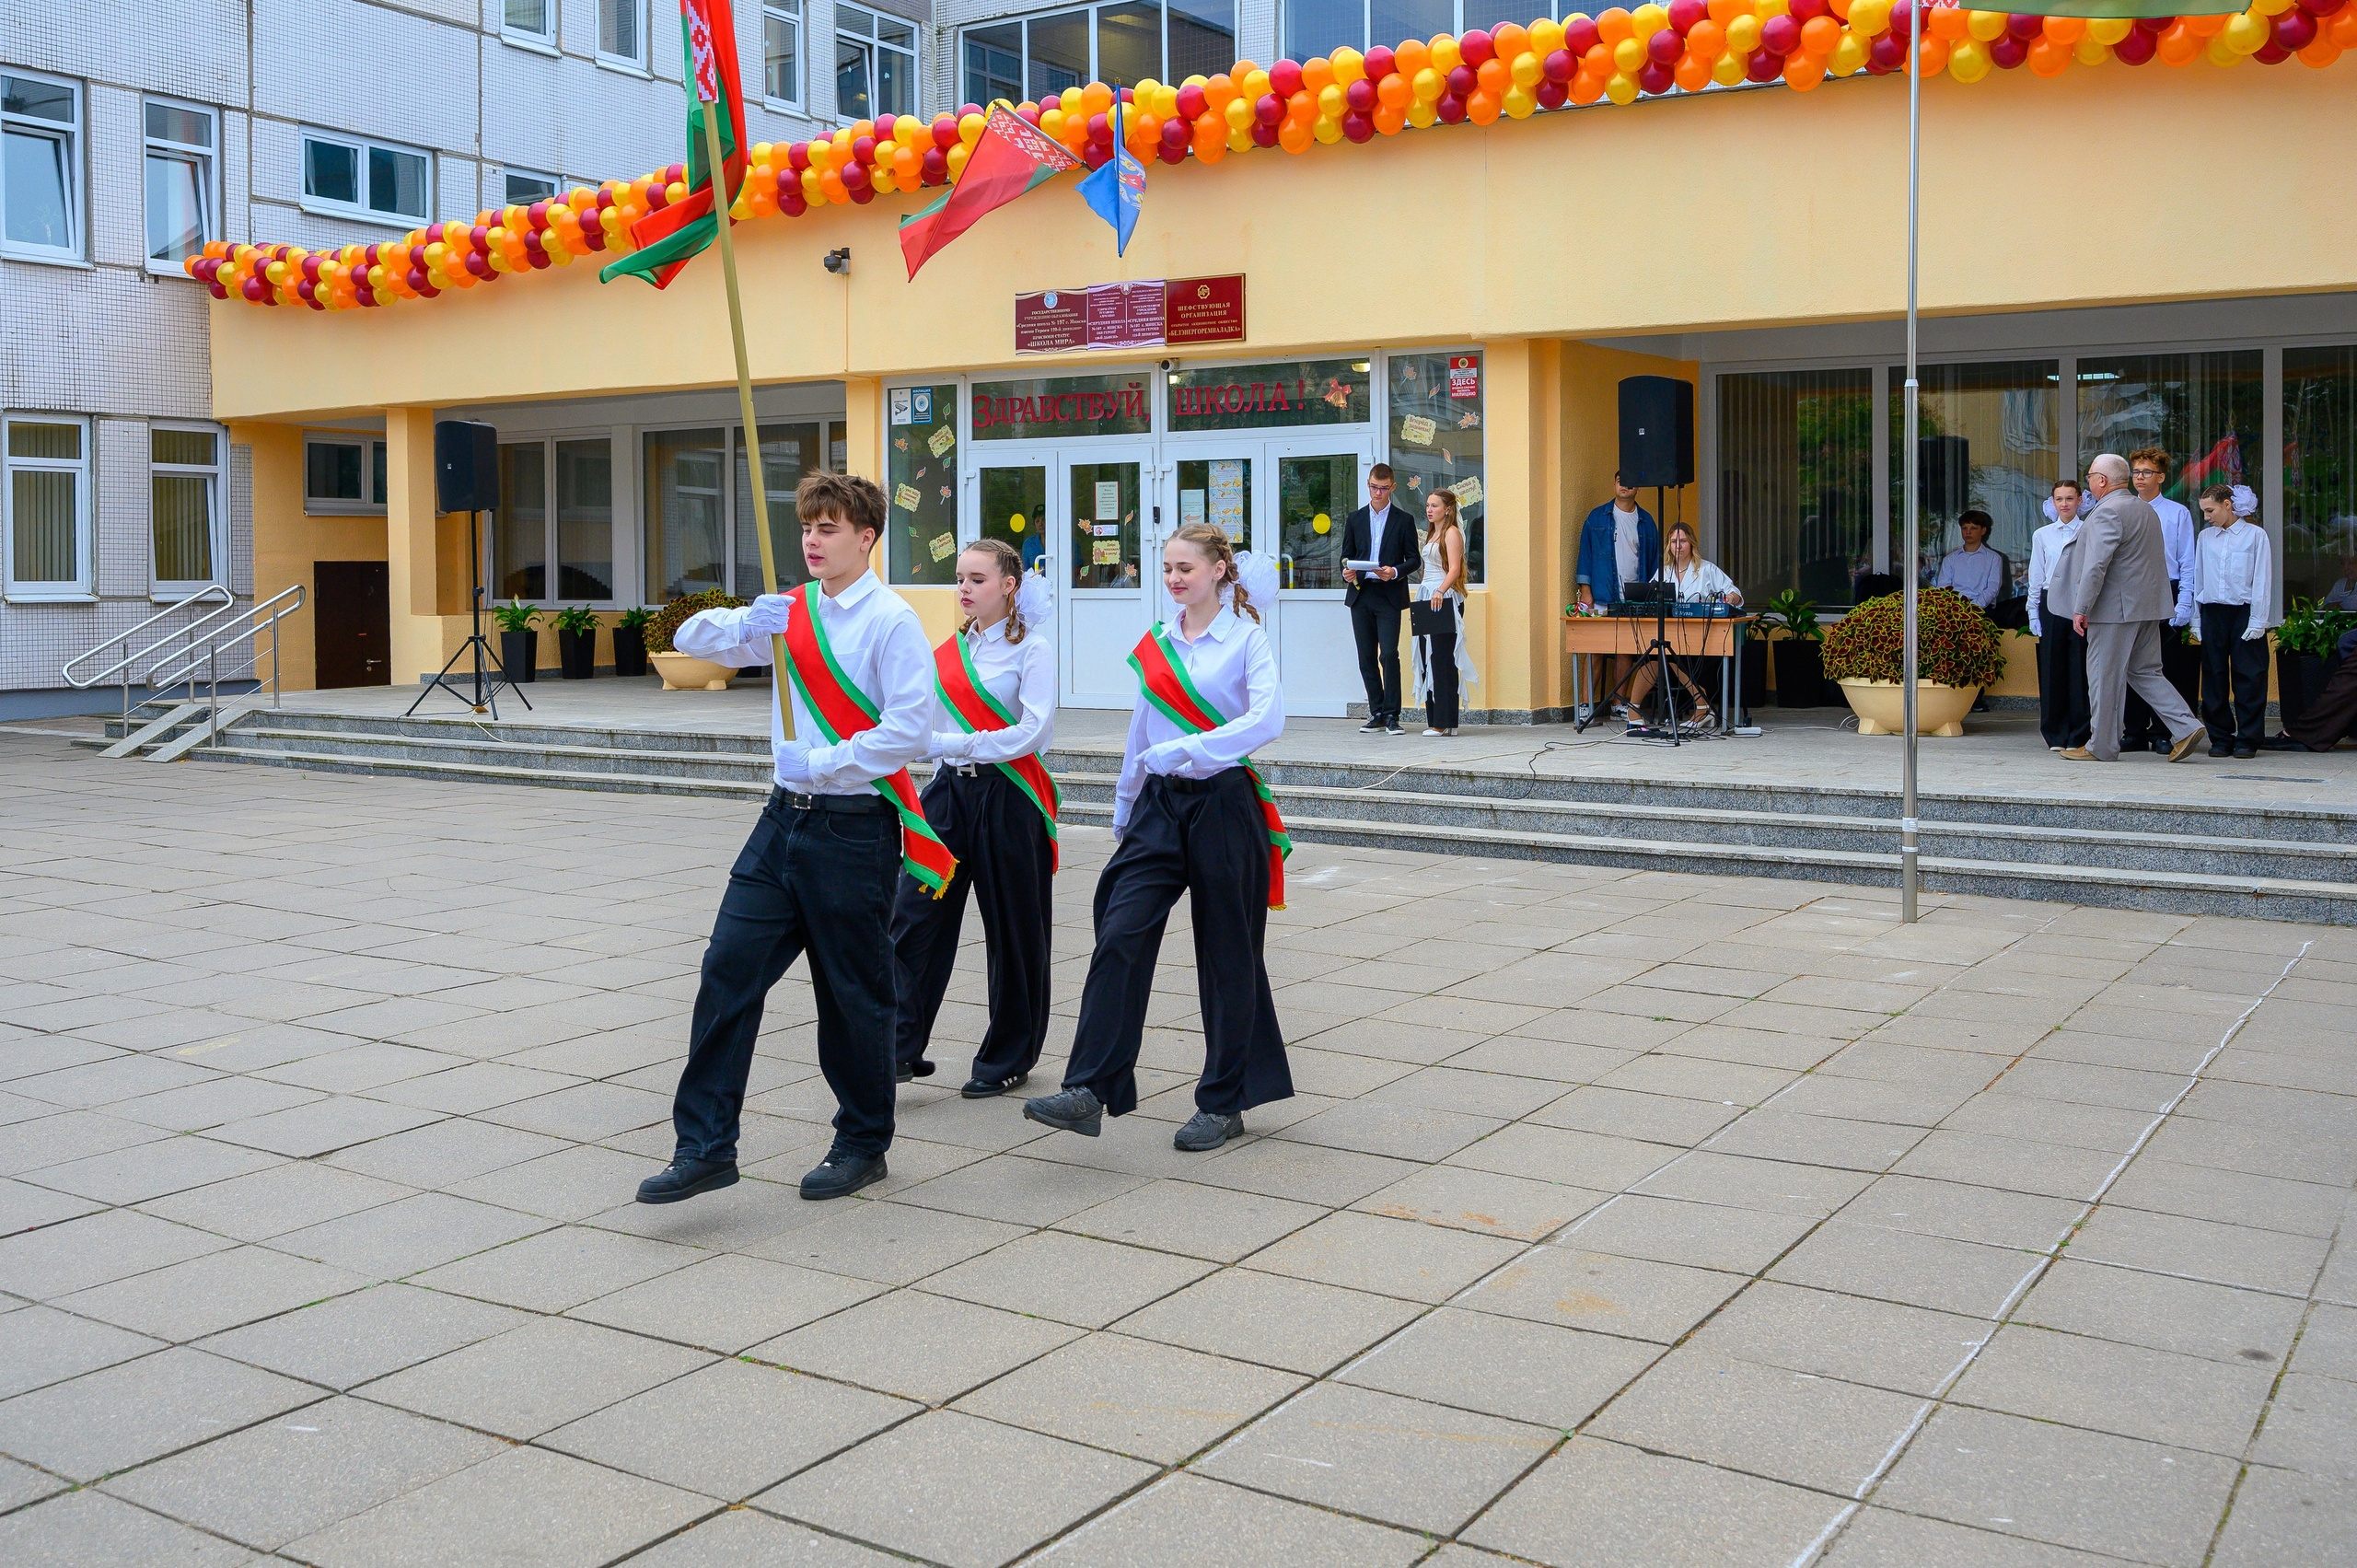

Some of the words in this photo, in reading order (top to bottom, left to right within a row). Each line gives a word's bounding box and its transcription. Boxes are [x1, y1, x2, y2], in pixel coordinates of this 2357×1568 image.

[1178, 302, 1230, 311] ШЕФСТВУЮЩАЯ
[1180, 310, 1227, 319] ОРГАНИЗАЦИЯ
[1168, 326, 1240, 336] «БЕЛЭНЕРГОРЕМНАЛАДКА»
[1452, 378, 1475, 387] ЗДЕСЬ
[973, 382, 1151, 428] ЗДРАВСТВУЙ,
